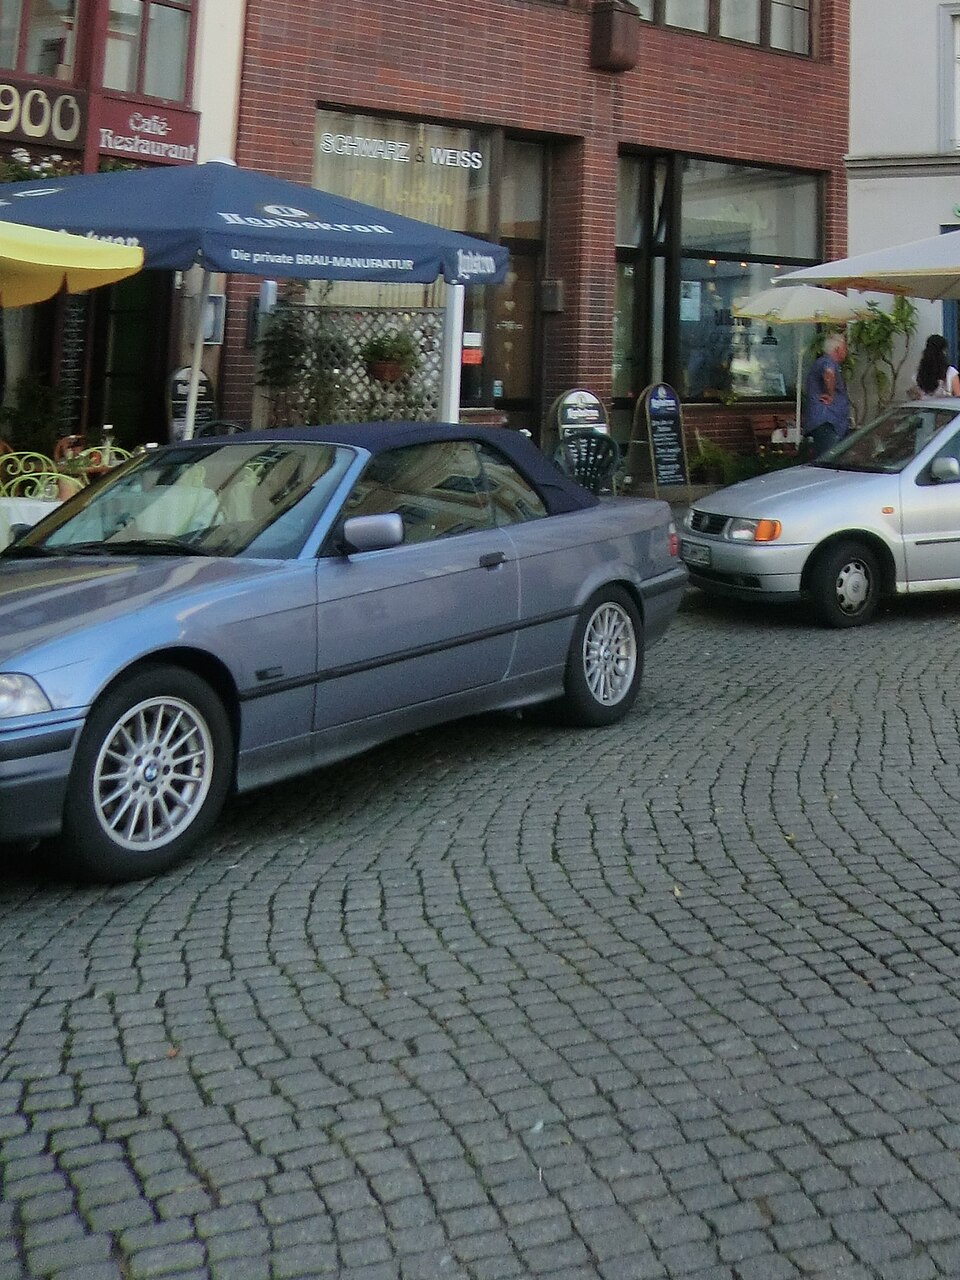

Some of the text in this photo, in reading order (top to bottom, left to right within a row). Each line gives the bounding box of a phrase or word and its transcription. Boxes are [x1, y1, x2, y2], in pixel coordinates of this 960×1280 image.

[99, 128, 196, 161] Restaurant
[320, 133, 483, 169] SCHWARZ & WEISS
[231, 249, 415, 271] Die private BRAU-MANUFAKTUR
